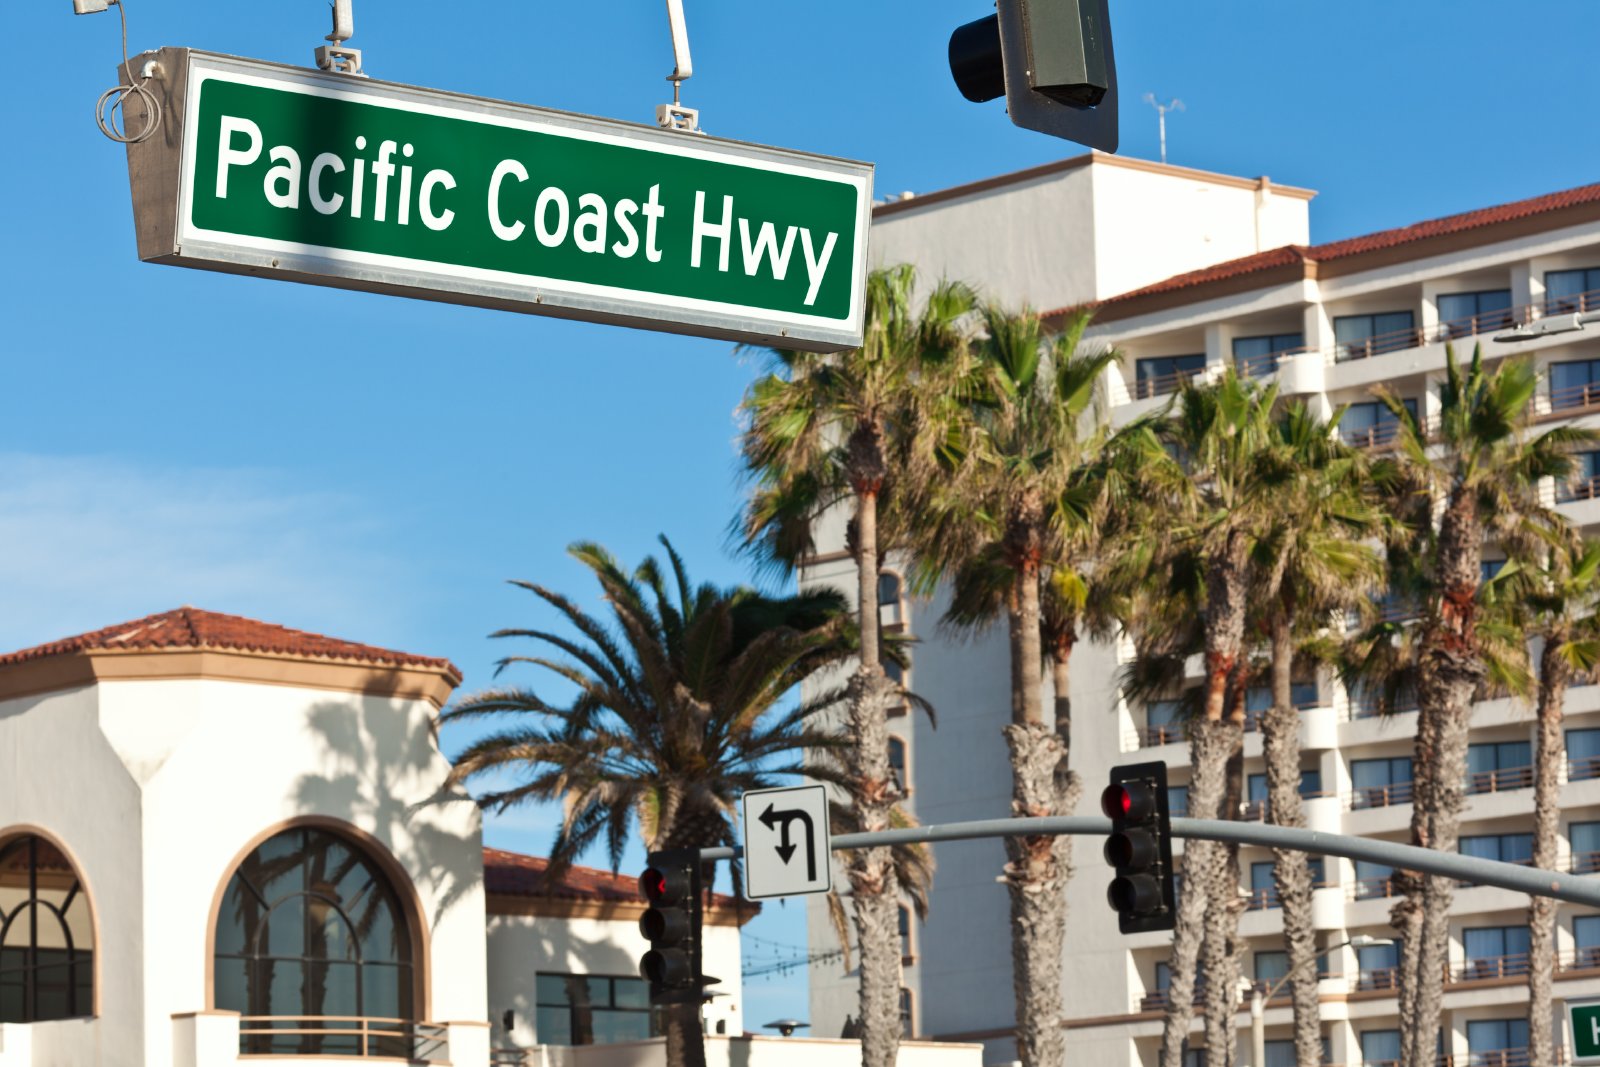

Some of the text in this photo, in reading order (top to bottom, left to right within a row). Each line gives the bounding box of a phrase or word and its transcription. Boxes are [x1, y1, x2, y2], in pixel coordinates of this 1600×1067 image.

[215, 114, 839, 306] Pacific Coast Hwy
